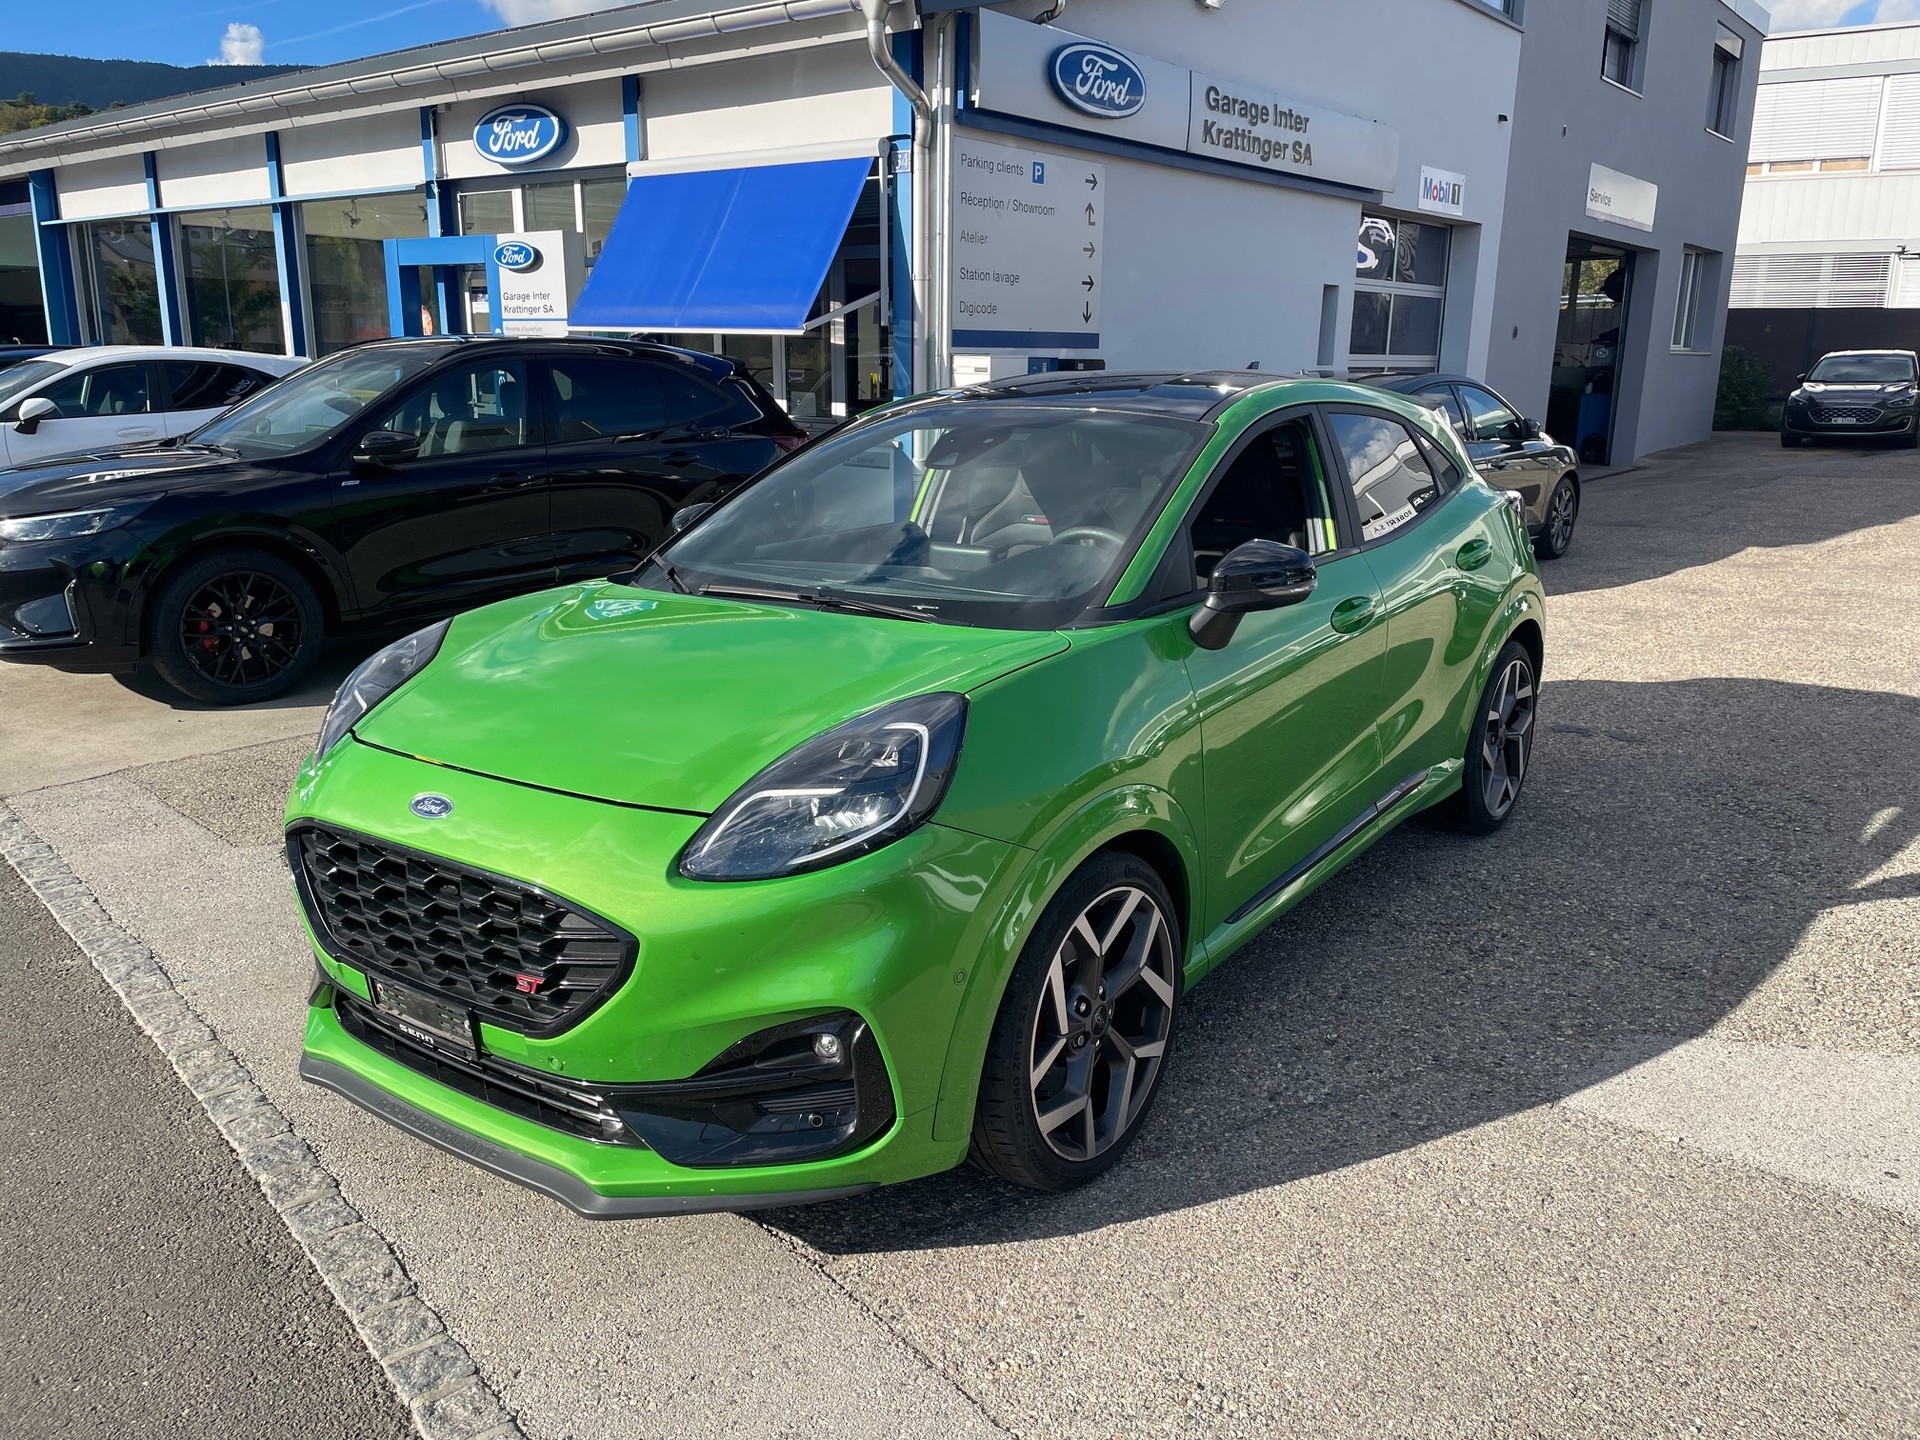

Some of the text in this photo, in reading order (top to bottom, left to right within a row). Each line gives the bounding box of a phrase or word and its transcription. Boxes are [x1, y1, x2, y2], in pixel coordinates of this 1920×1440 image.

[1076, 54, 1131, 106] Ford
[1205, 86, 1310, 134] Garage Inter
[489, 114, 540, 153] Ford
[1202, 119, 1312, 166] Krattinger SA
[961, 153, 994, 174] Parking
[996, 162, 1024, 176] clients
[1423, 177, 1451, 204] Mobil
[1590, 187, 1611, 207] Service
[960, 192, 1005, 210] Réception
[1013, 199, 1056, 216] Showroom
[960, 230, 988, 244] Atelier
[501, 246, 526, 264] Ford
[960, 267, 1020, 286] Station lavage
[503, 291, 550, 302] Garage Inter
[503, 304, 554, 315] Krattinger SA
[959, 301, 997, 316] Digicode
[417, 797, 445, 814] Ford
[516, 973, 545, 994] ST
